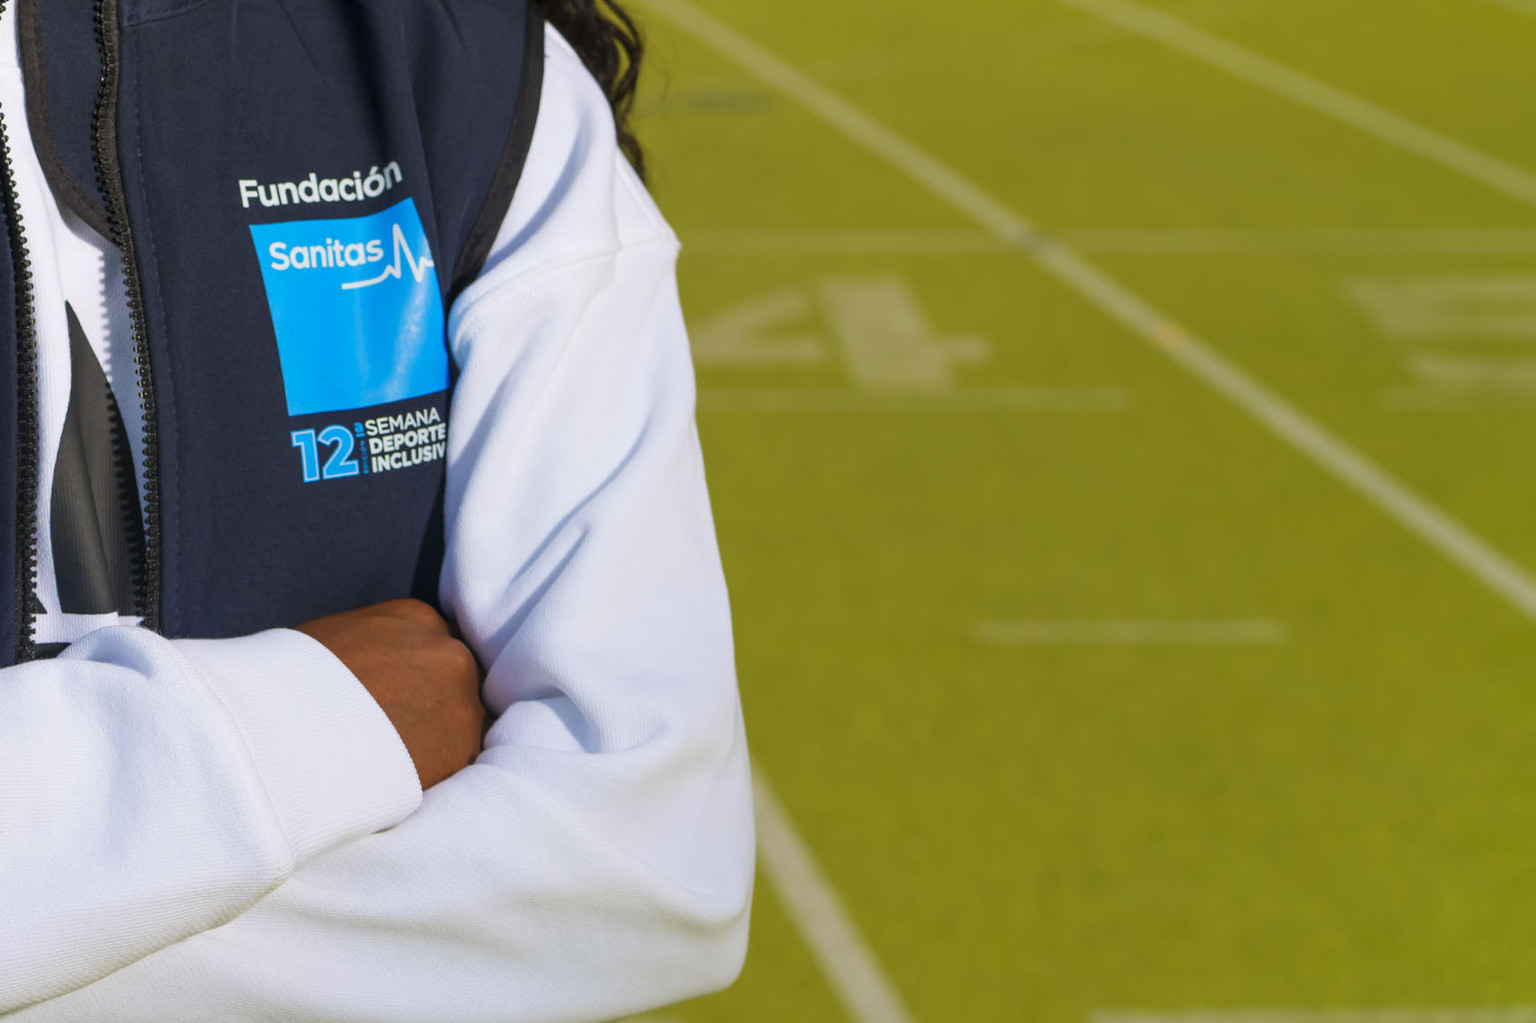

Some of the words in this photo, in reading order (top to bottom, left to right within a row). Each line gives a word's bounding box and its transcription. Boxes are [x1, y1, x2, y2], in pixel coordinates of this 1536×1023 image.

[238, 161, 403, 208] Fundación
[269, 238, 384, 271] Sanitas
[692, 275, 994, 388] 4
[365, 407, 441, 436] SEMANA
[368, 422, 446, 455] DEPORTE
[371, 441, 446, 473] INCLUSIV
